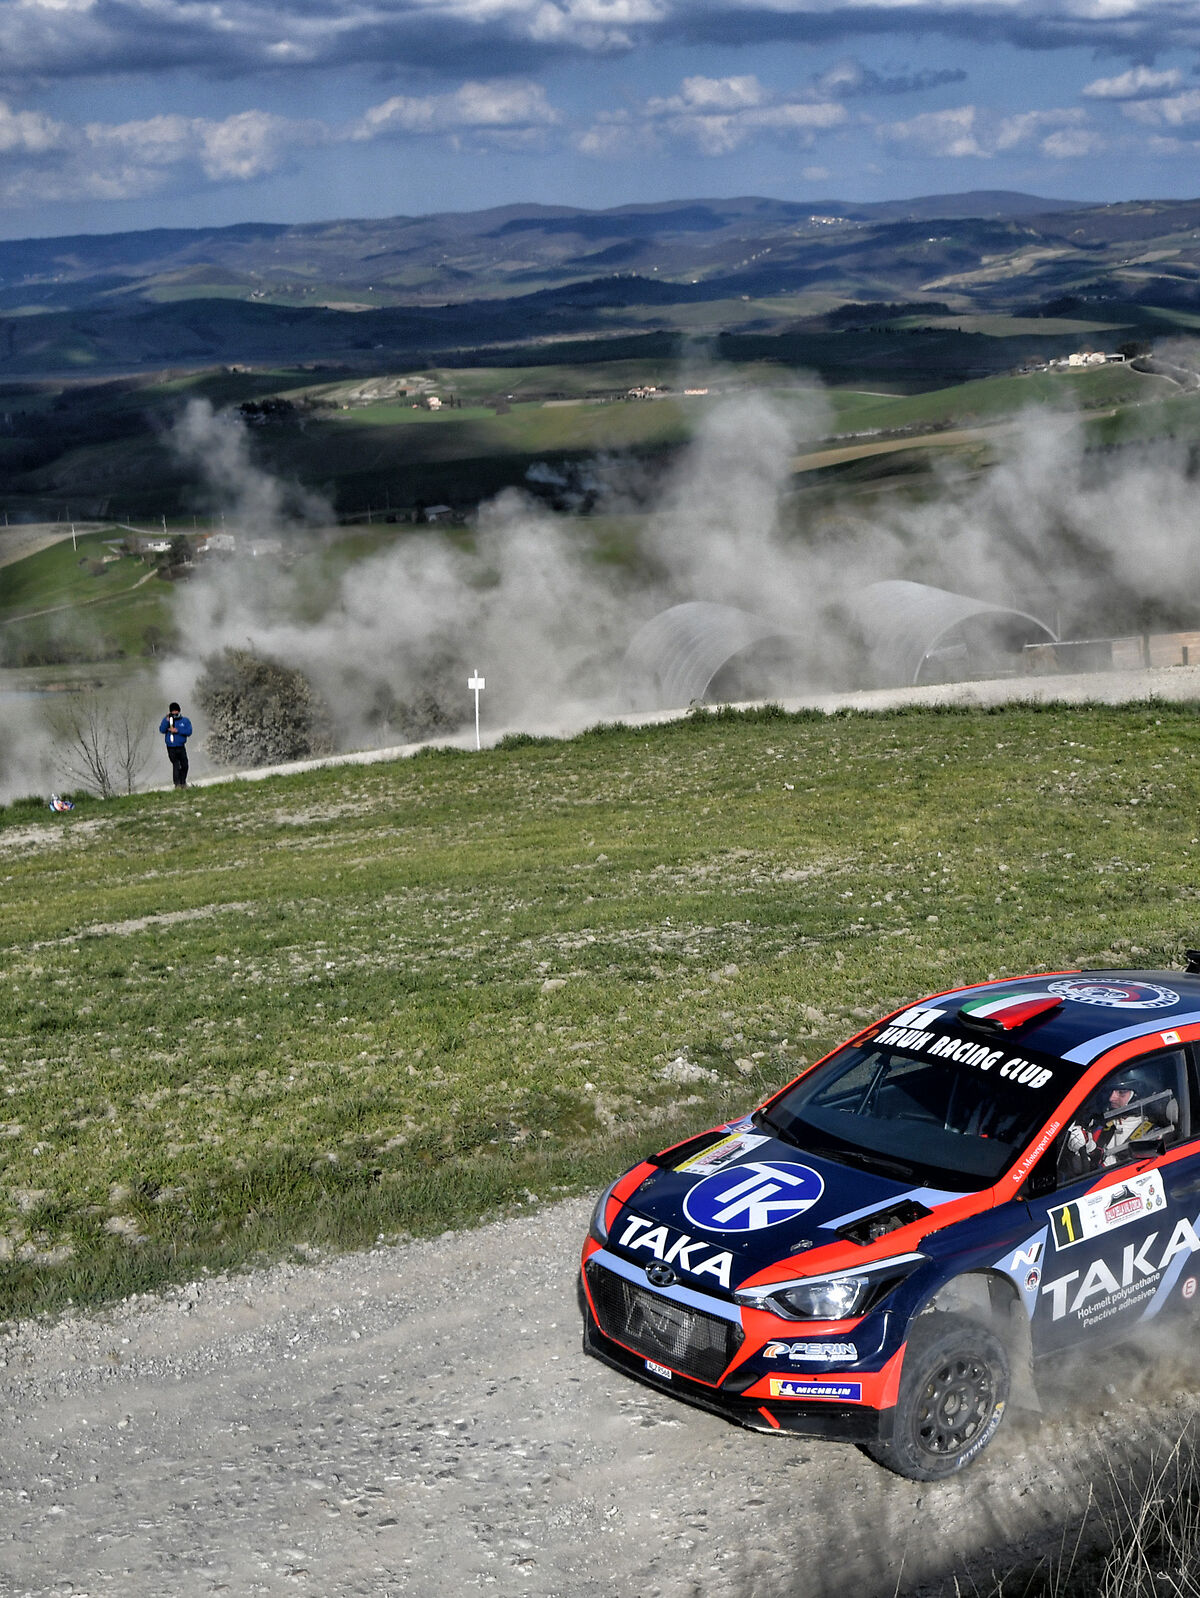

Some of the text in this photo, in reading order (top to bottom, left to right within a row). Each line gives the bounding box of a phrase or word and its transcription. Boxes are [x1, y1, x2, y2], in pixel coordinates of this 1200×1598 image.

[873, 1026, 1054, 1089] HAWK RACING CLUB
[1022, 1135, 1050, 1169] Motorsport
[1045, 1121, 1061, 1137] Italia
[1060, 1206, 1076, 1243] 1
[618, 1214, 734, 1289] TAKA
[1077, 1272, 1160, 1319] Hot-melt polyurethane
[1118, 1286, 1157, 1311] adhesives
[789, 1342, 858, 1355] PERIN
[795, 1386, 852, 1396] MICHELIN
